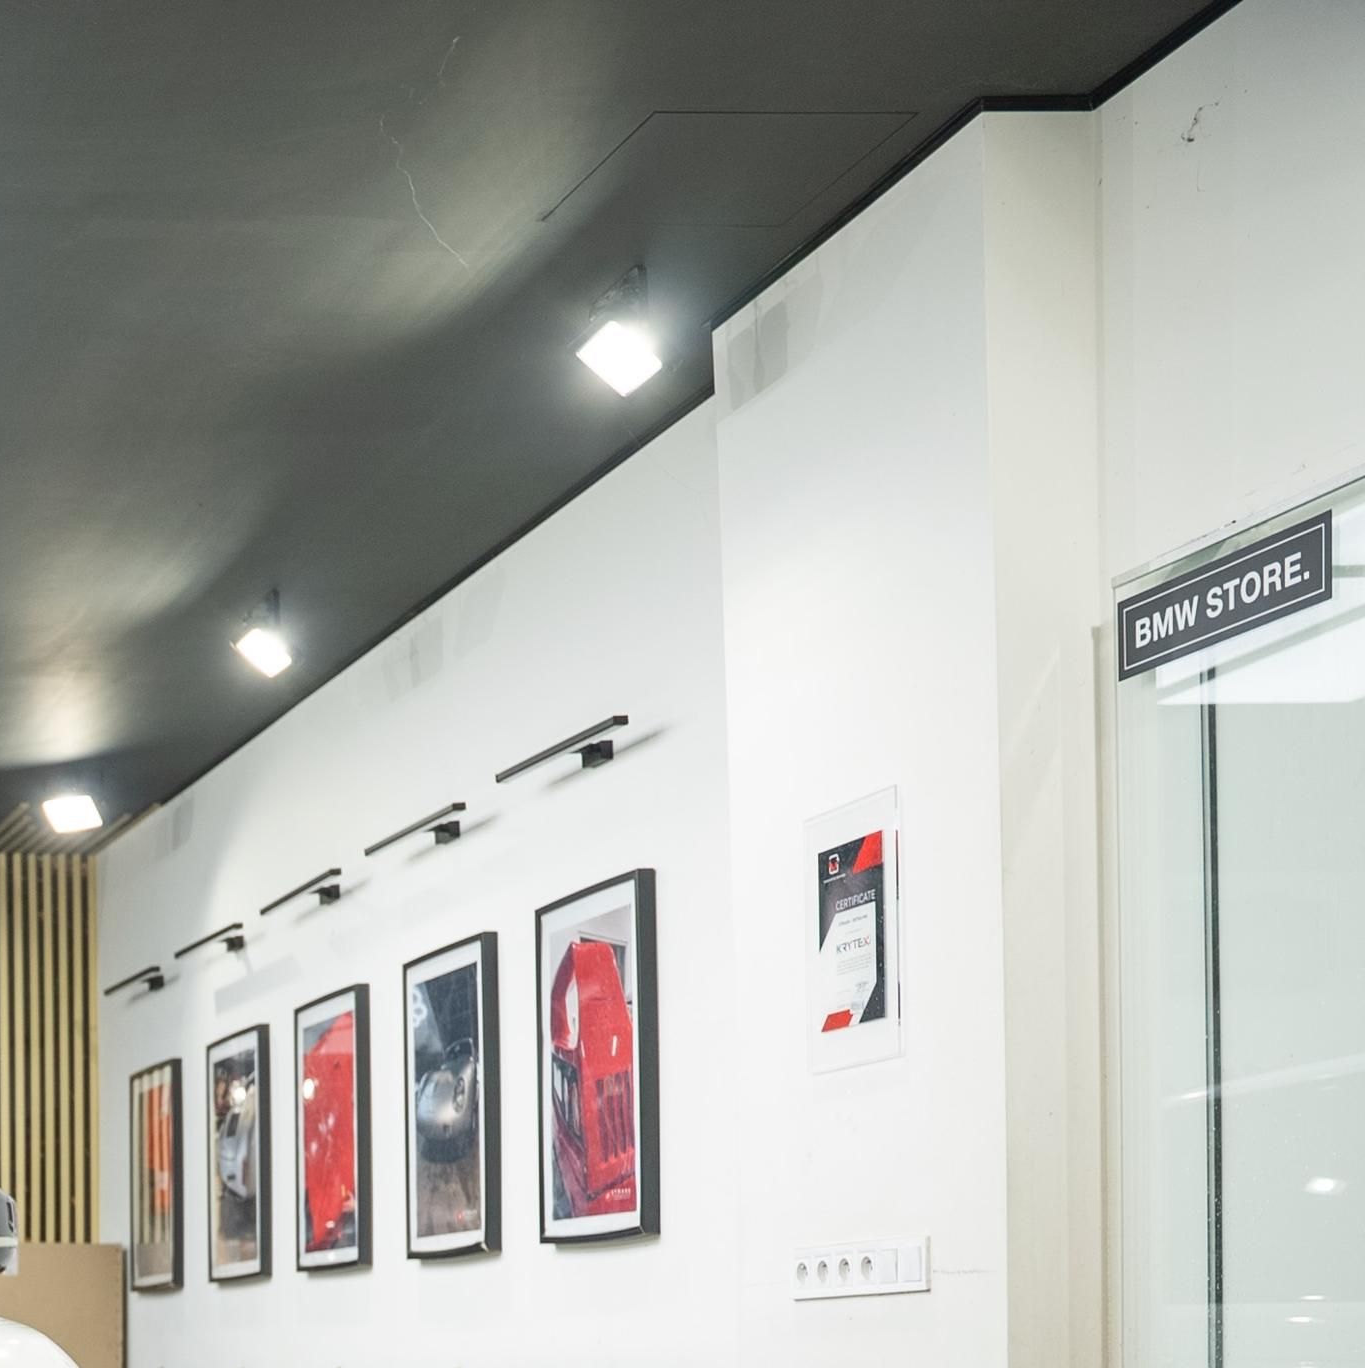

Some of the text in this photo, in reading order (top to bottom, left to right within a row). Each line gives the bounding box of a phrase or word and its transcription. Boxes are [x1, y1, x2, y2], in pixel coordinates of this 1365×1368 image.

[1135, 551, 1311, 650] BMW STORE.
[835, 889, 876, 911] CERTIFICATE
